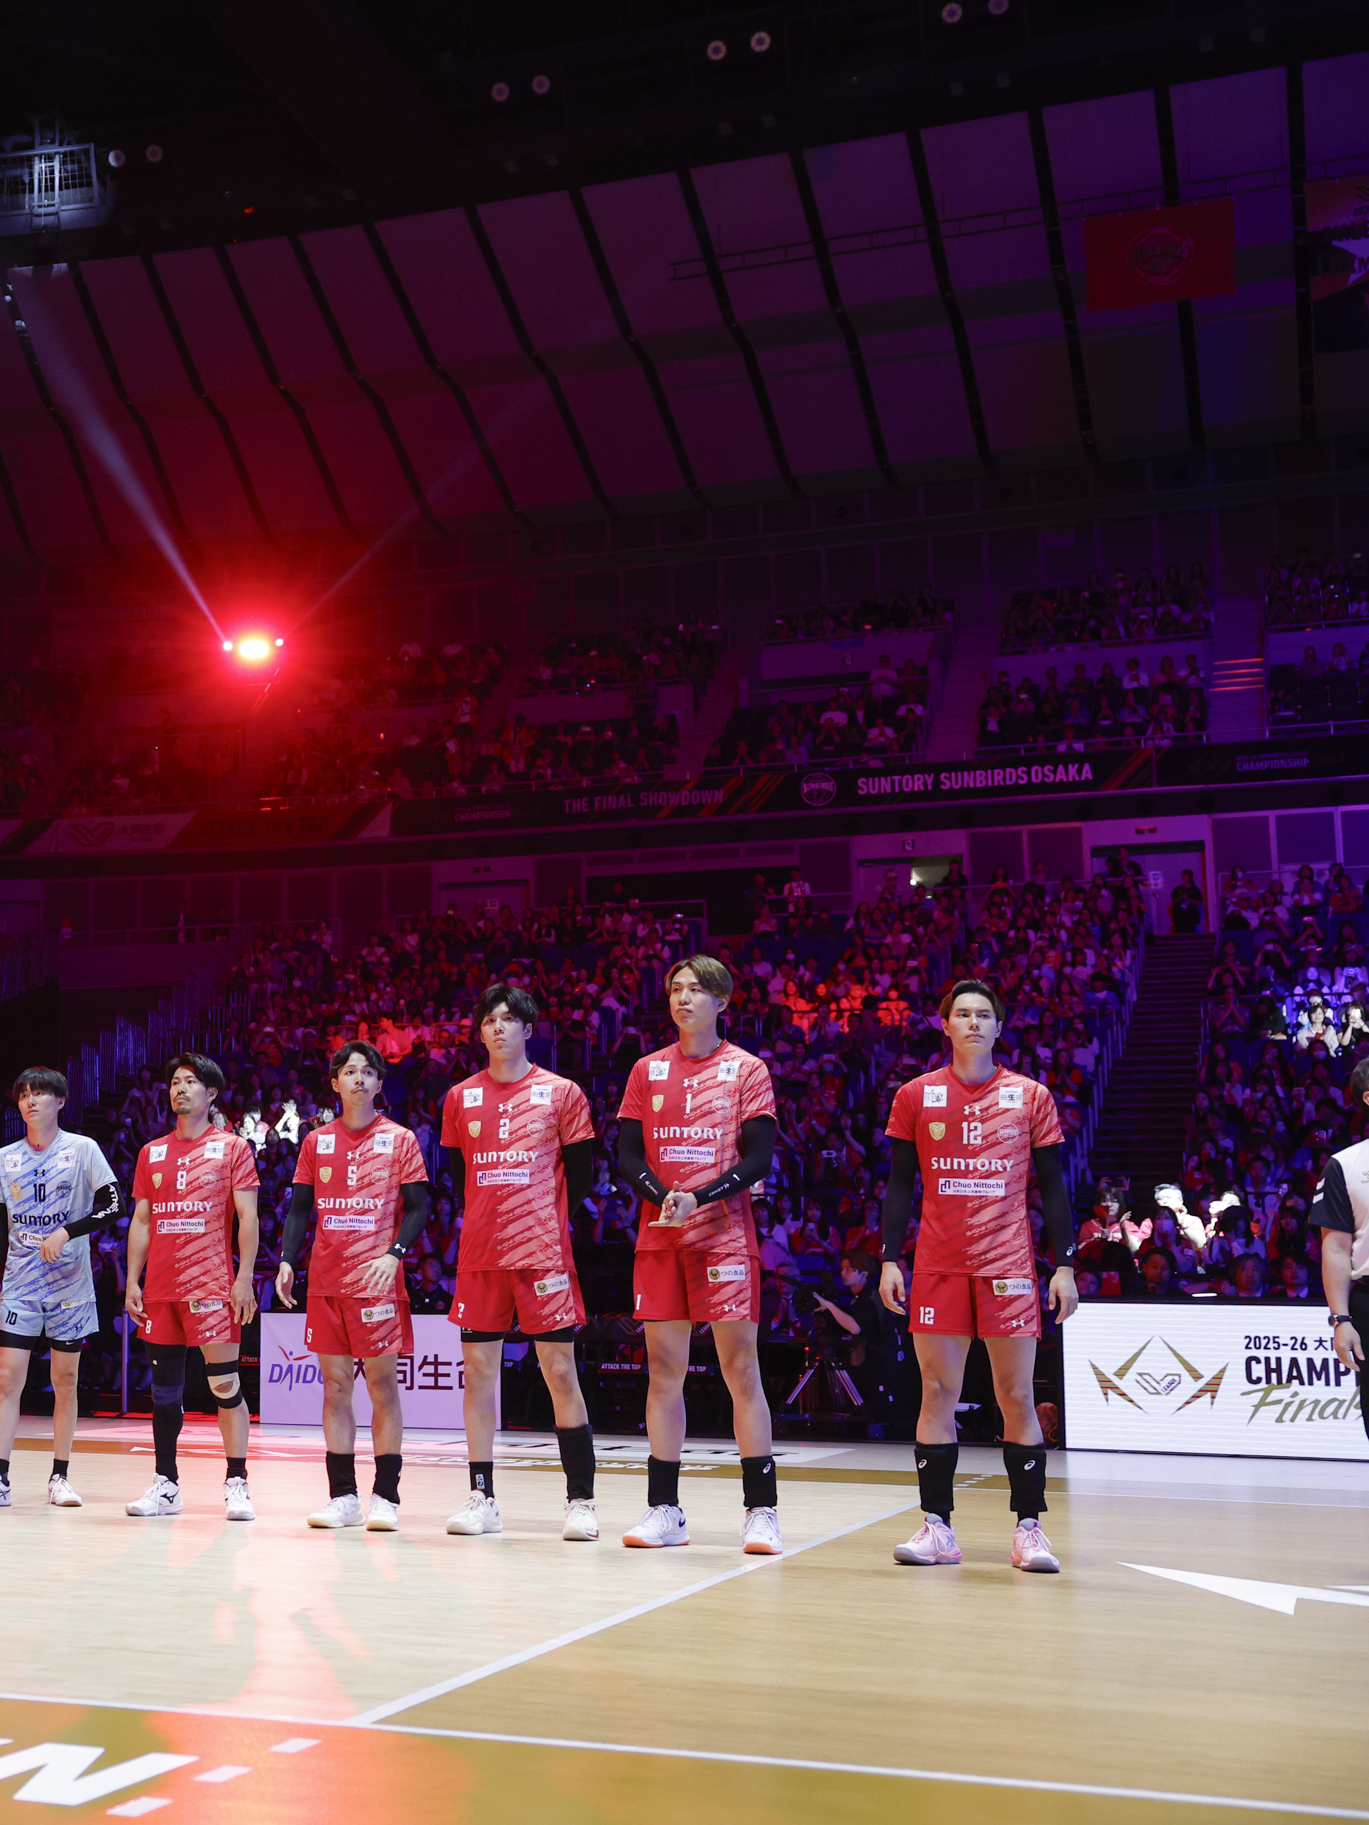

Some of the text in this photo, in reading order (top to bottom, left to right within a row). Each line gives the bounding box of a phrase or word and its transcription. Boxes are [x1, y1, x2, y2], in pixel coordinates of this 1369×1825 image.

[857, 762, 1093, 796] SUNTORY SUNBIRDS OSAKA
[563, 788, 723, 814] THE FINAL SHOWDOWN
[685, 1093, 692, 1114] 1
[498, 1118, 510, 1139] 2
[653, 1126, 724, 1140] SUNTORY
[961, 1121, 983, 1145] 12
[473, 1150, 539, 1165] SUNTORY
[668, 1148, 714, 1157] Chuo Nittochi
[931, 1156, 1015, 1172] SUNTORY
[176, 1170, 187, 1190] 8
[346, 1165, 358, 1186] 5
[502, 1171, 529, 1179] Nittochi
[32, 1183, 46, 1203] 10
[952, 1181, 1003, 1189] Chuo Nittochi
[152, 1201, 213, 1214] SUNTORY
[317, 1197, 385, 1210] SUNTORY
[11, 1210, 70, 1227] SUNTORY
[180, 1220, 204, 1228] Nittochi
[333, 1217, 374, 1225] Chuo Nittochi
[28, 1234, 42, 1242] Chuo
[635, 1294, 642, 1310] 1
[5, 1310, 18, 1326] 10
[919, 1306, 935, 1325] 12
[145, 1319, 152, 1334] 8
[306, 1328, 313, 1344] 5
[1243, 1335, 1308, 1352] 2025-26
